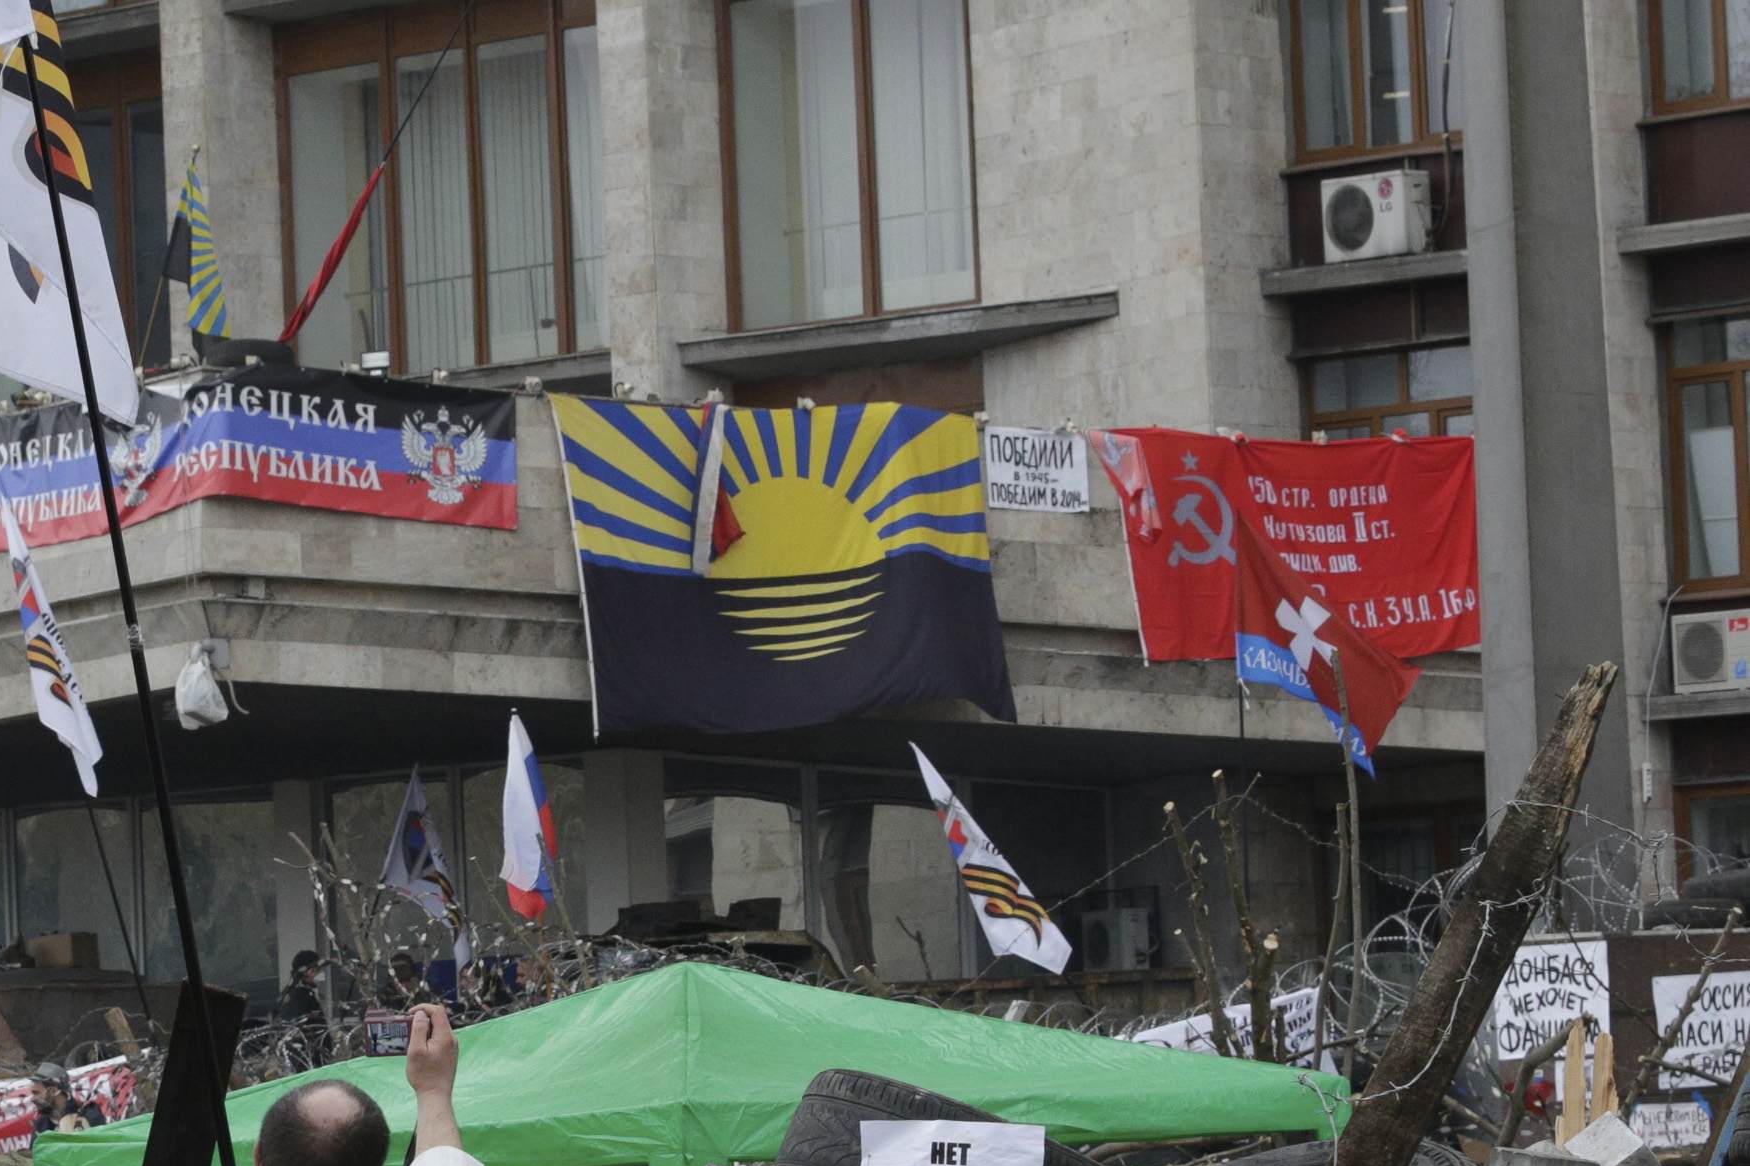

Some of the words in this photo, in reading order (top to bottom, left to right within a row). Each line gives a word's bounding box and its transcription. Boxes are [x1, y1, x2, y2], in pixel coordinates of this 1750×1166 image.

[1379, 202, 1393, 213] LG
[173, 439, 383, 491] РЕСПУБЛИКА
[990, 434, 1074, 470] ПОБЕДИЛИ
[991, 482, 1047, 506] ПОБЕДИМ
[1051, 488, 1058, 506] В
[1329, 485, 1388, 508] ОРДЕНА
[1505, 954, 1594, 991] ДОНБАСС
[1701, 982, 1750, 1011] ОССИ
[930, 1141, 971, 1166] НЕТ
